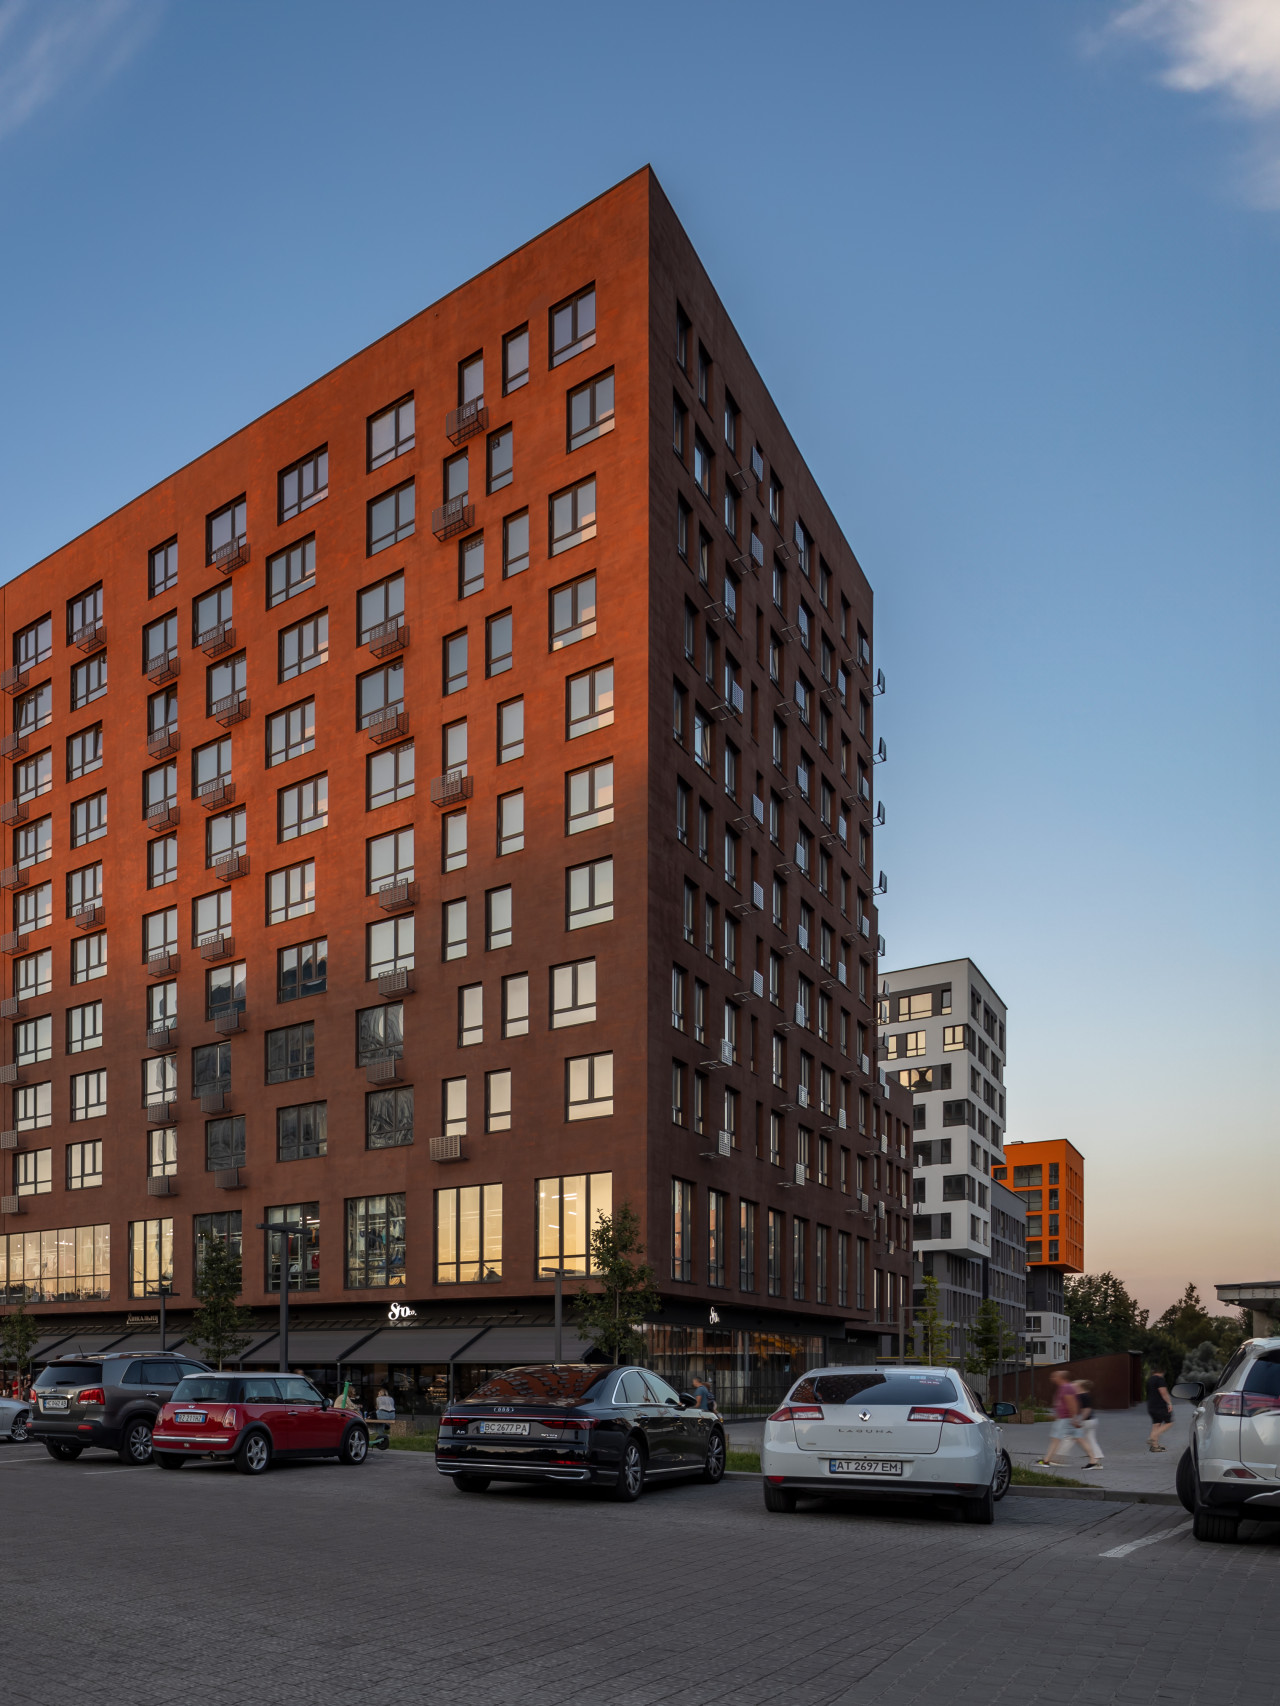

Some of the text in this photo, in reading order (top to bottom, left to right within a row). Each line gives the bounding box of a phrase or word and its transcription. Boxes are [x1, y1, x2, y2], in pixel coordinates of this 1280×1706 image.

[484, 1423, 528, 1432] BC 2677 PA
[836, 1461, 898, 1472] AT 2697 EM
